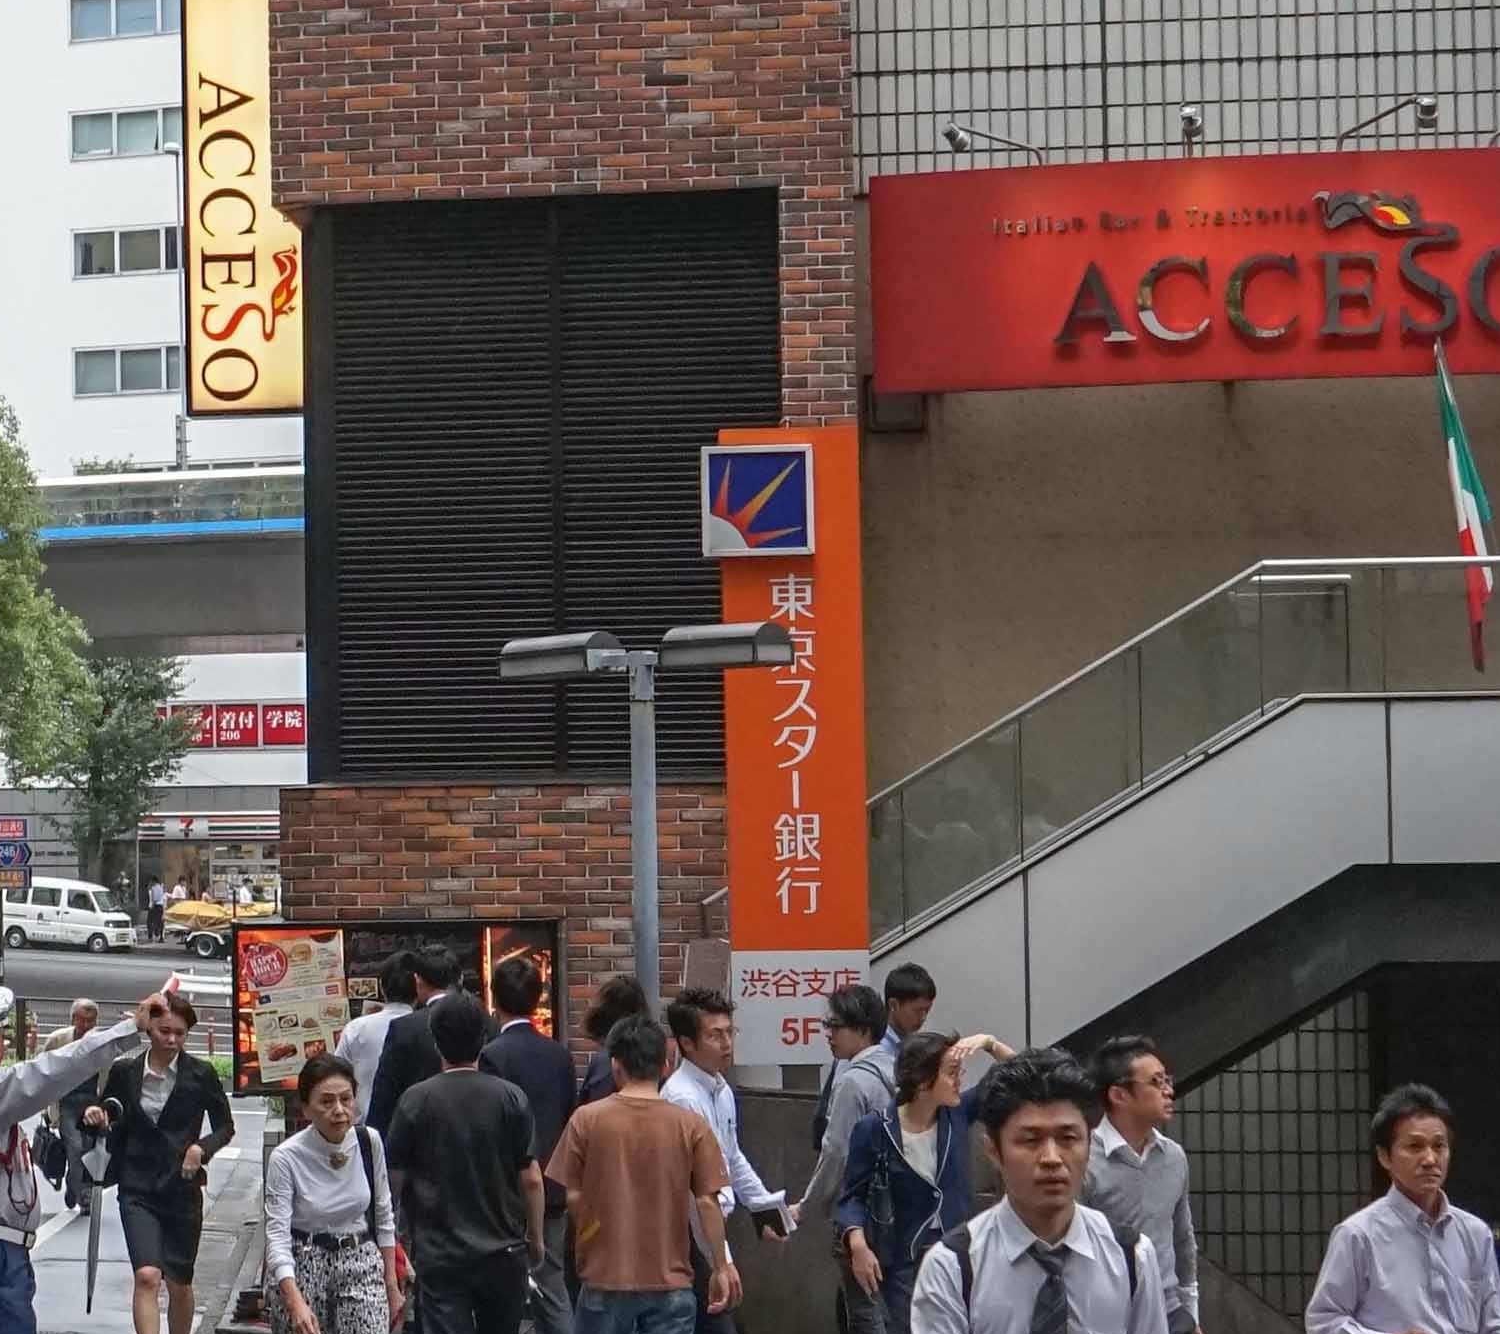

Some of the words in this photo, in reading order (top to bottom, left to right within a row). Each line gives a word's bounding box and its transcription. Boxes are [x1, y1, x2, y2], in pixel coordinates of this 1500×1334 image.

[199, 72, 275, 402] ACCESO
[992, 216, 1084, 236] Italian
[768, 572, 822, 915] 東京スター銀行
[741, 968, 860, 998] 渋谷支店
[781, 1017, 822, 1046] 5F
